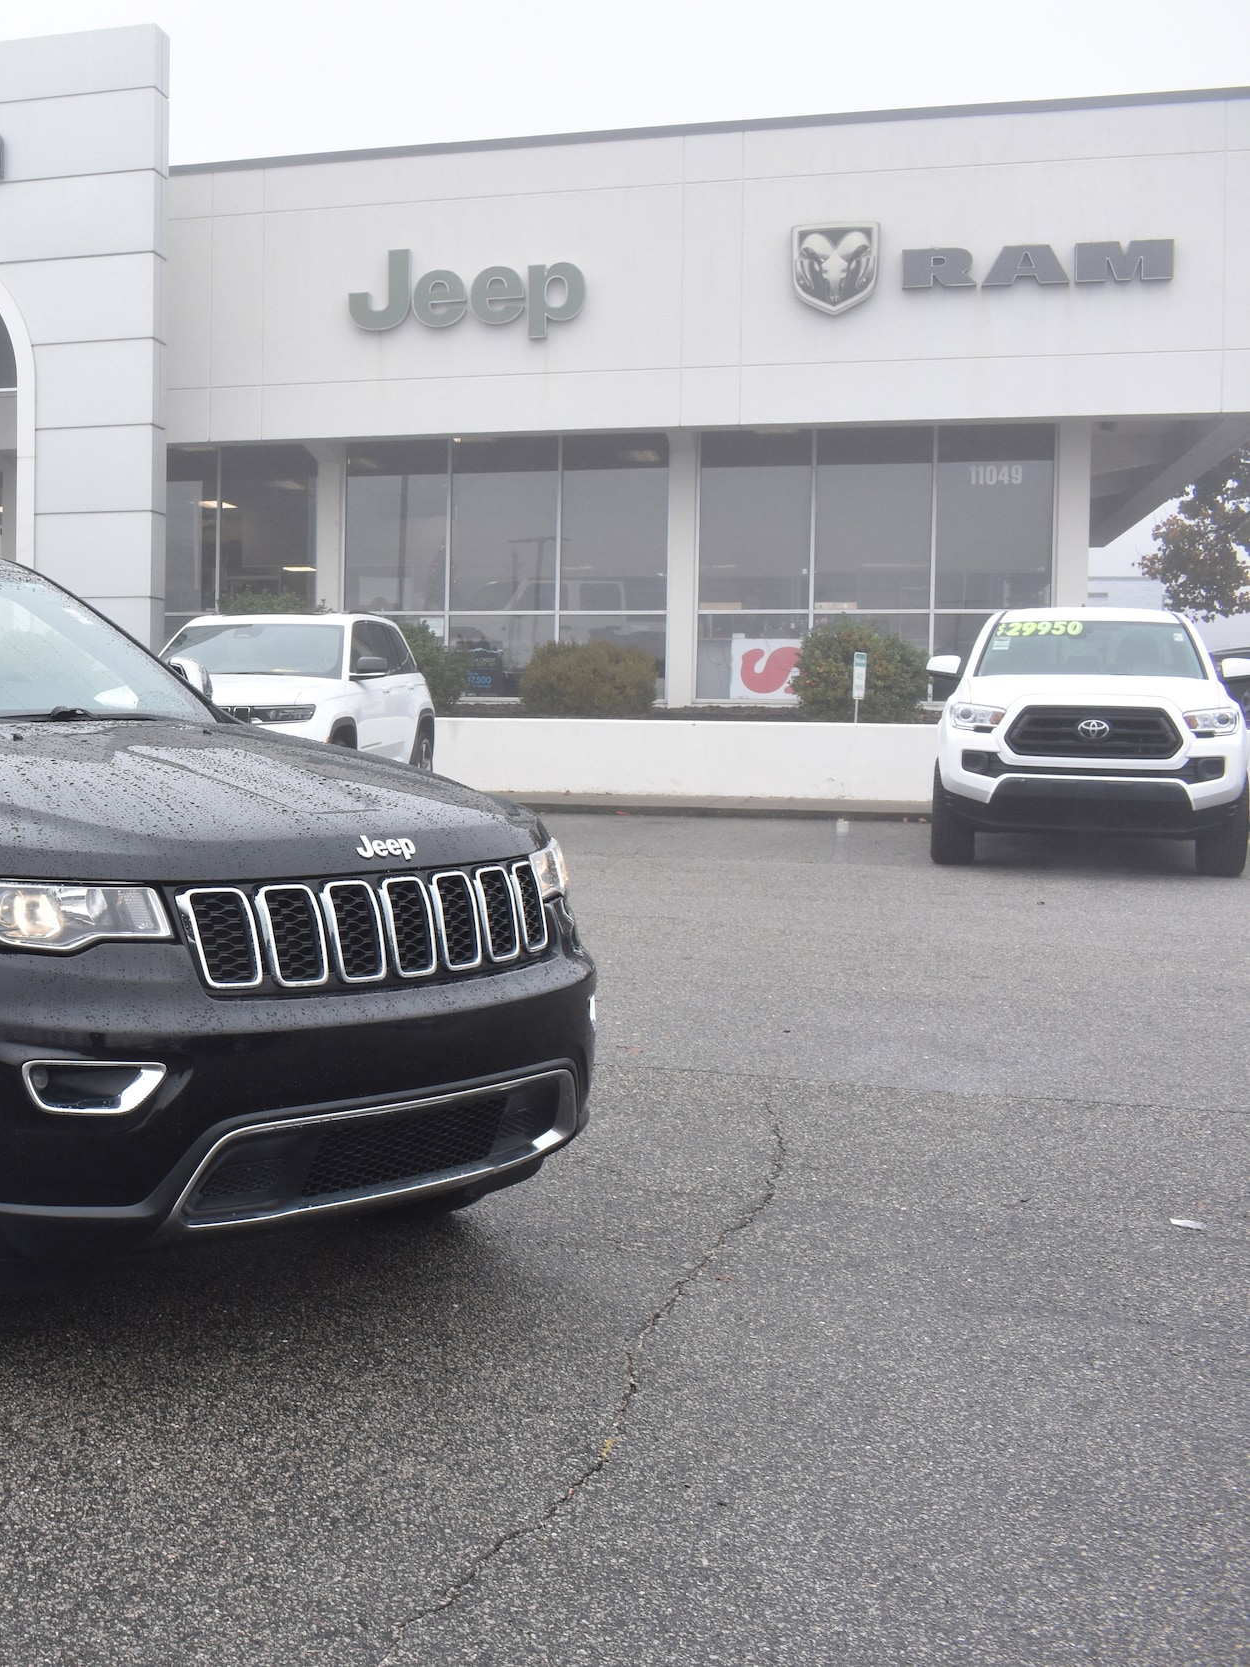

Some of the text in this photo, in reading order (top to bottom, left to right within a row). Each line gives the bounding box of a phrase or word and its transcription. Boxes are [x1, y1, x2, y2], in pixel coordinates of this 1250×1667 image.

[902, 239, 1175, 289] RAM
[348, 249, 587, 339] Jeep
[969, 465, 1023, 485] 11049
[997, 621, 1084, 637] $29950
[355, 834, 416, 861] Jeep
